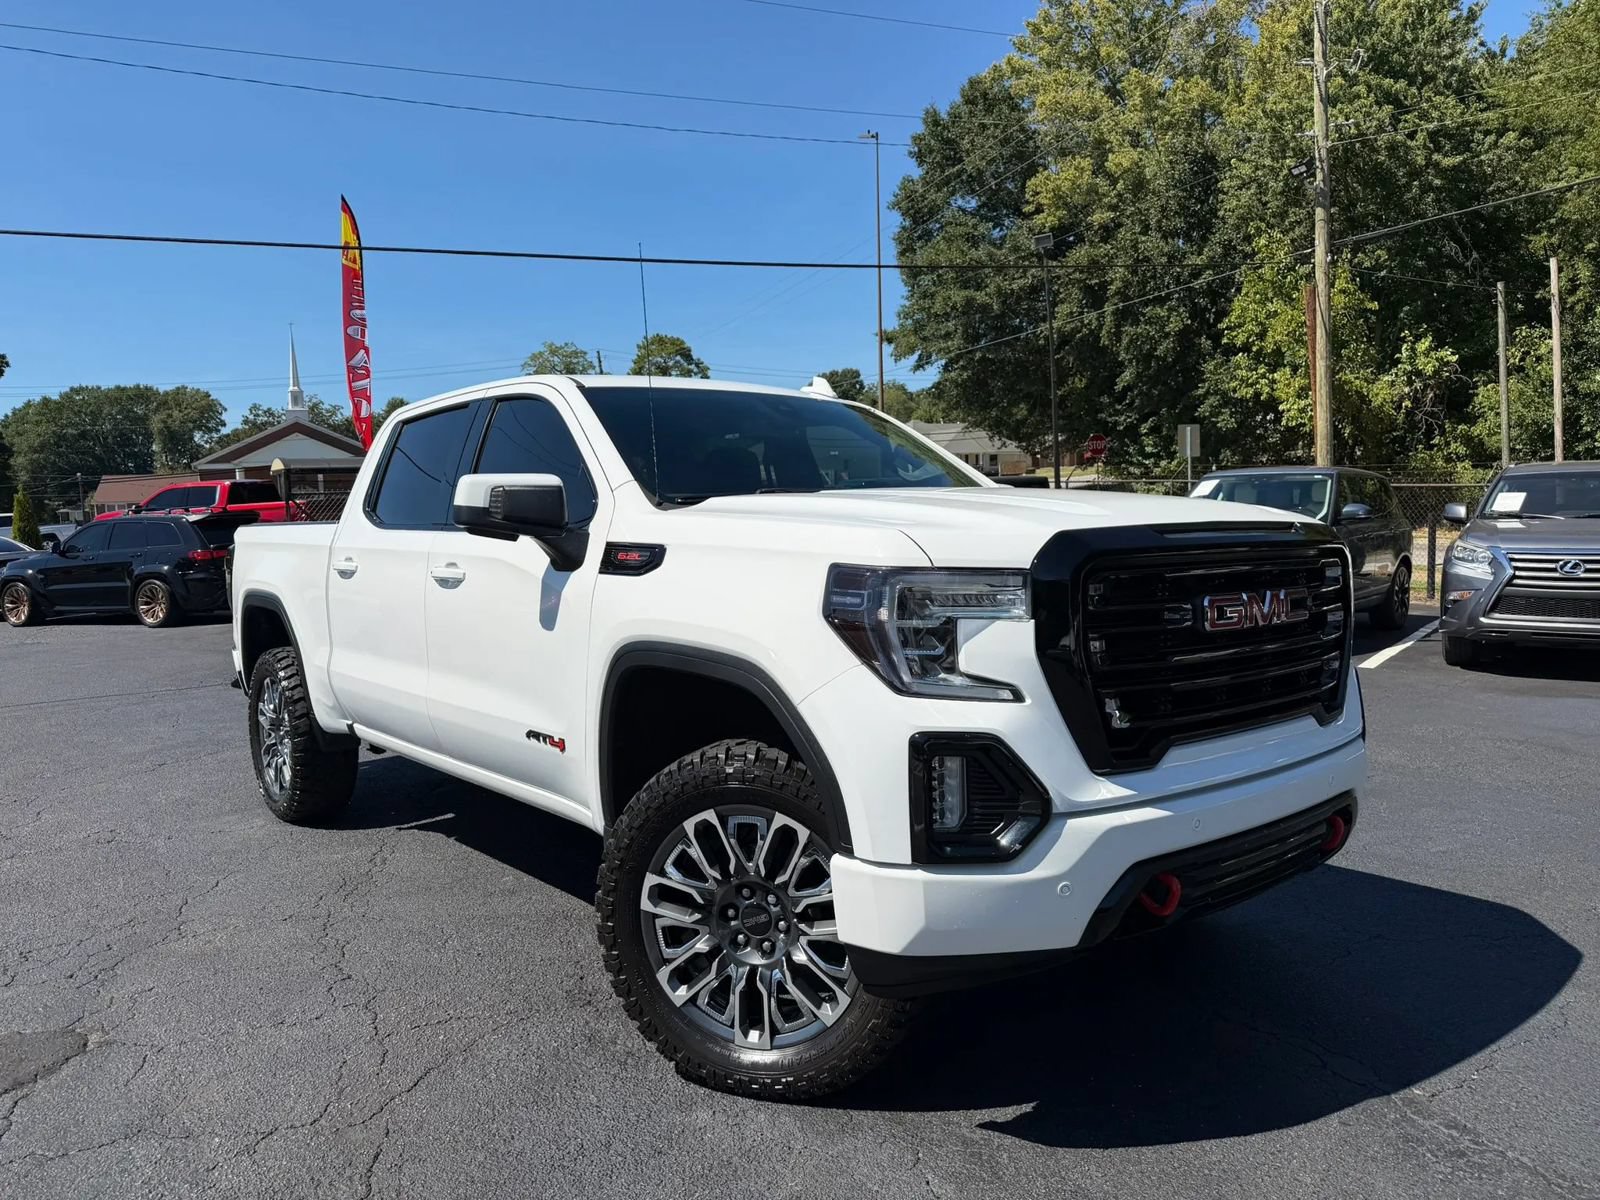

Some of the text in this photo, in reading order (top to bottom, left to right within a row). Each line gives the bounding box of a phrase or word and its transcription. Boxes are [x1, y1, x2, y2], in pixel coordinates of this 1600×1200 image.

[1088, 440, 1105, 449] STOP
[1203, 588, 1309, 631] GMC
[525, 729, 566, 754] AT4
